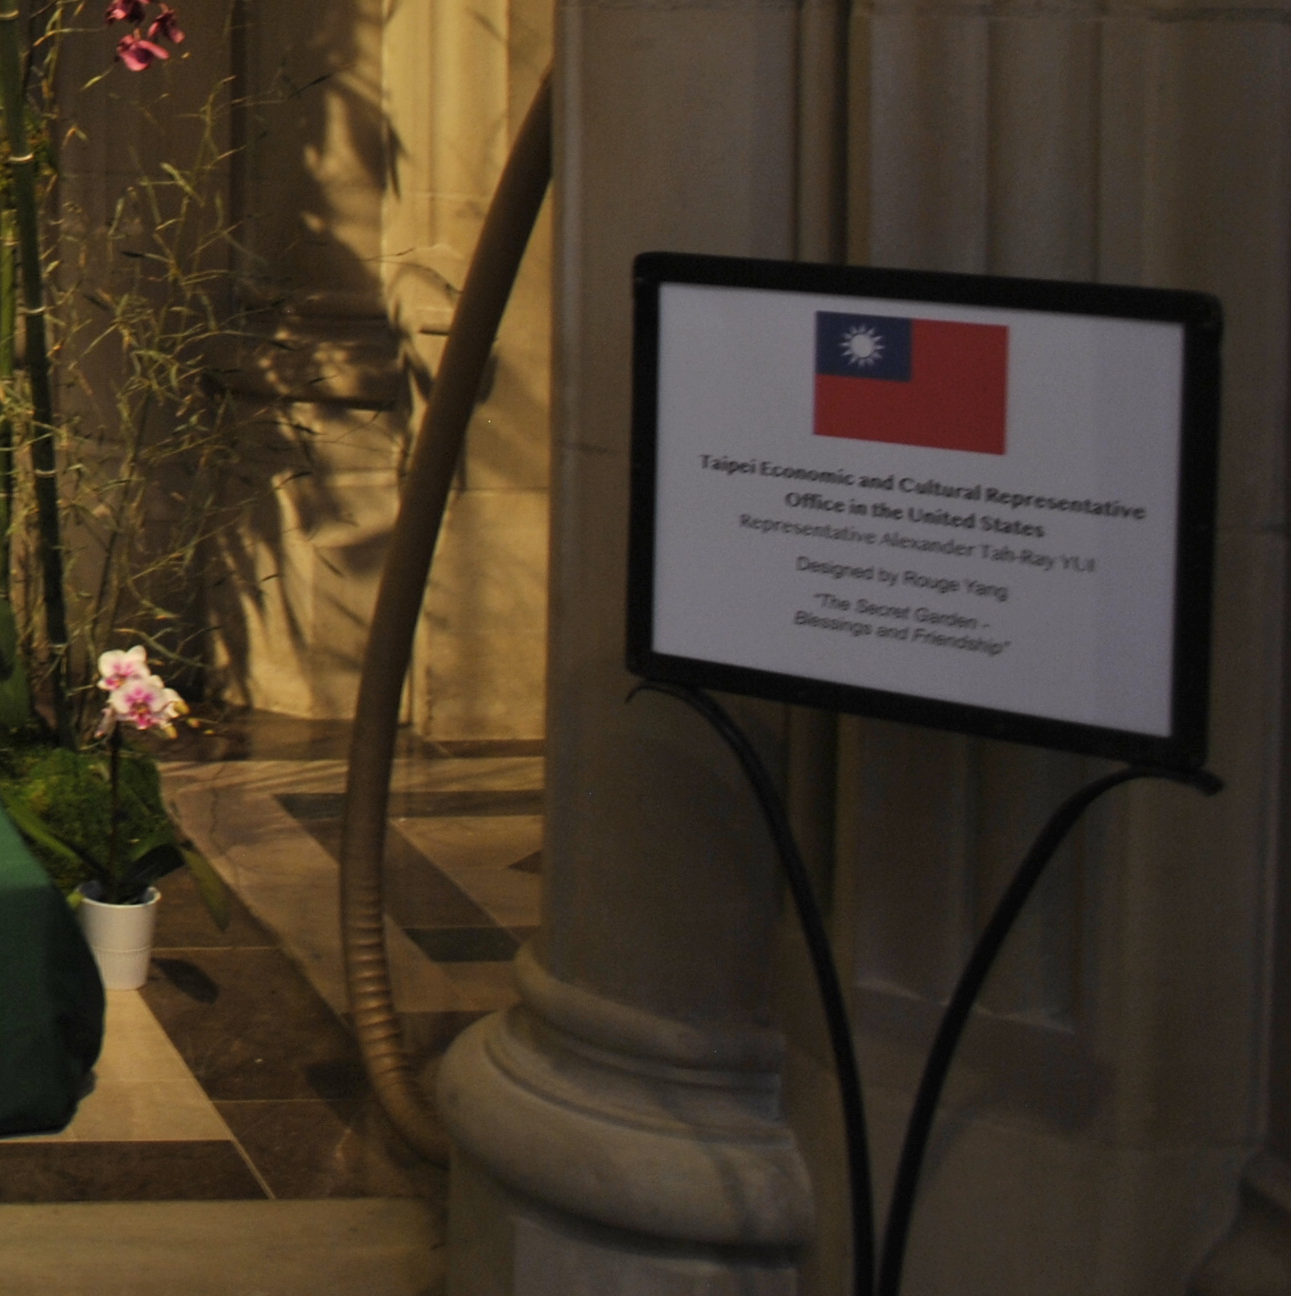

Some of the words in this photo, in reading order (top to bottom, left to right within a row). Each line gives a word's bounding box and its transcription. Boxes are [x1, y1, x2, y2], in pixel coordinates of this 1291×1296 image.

[700, 454, 757, 475] Taipei
[759, 461, 856, 486] Economic
[858, 474, 895, 492] and
[899, 476, 982, 501] Cultural
[985, 487, 1147, 520] Representative
[785, 491, 847, 513] Office
[849, 498, 868, 516] in
[871, 502, 904, 520] the
[906, 506, 976, 529] United
[979, 515, 1046, 538] States
[739, 513, 877, 545] Representative
[879, 531, 976, 558] Alexander
[980, 543, 1055, 572] Tah-Ray
[796, 556, 875, 580] Designed
[877, 567, 898, 587] by
[902, 570, 960, 594] Rouge
[963, 578, 1008, 603] Yang
[794, 609, 873, 637] Blessings
[875, 625, 909, 641] and
[855, 598, 910, 620] Secret
[914, 606, 978, 630] Garden
